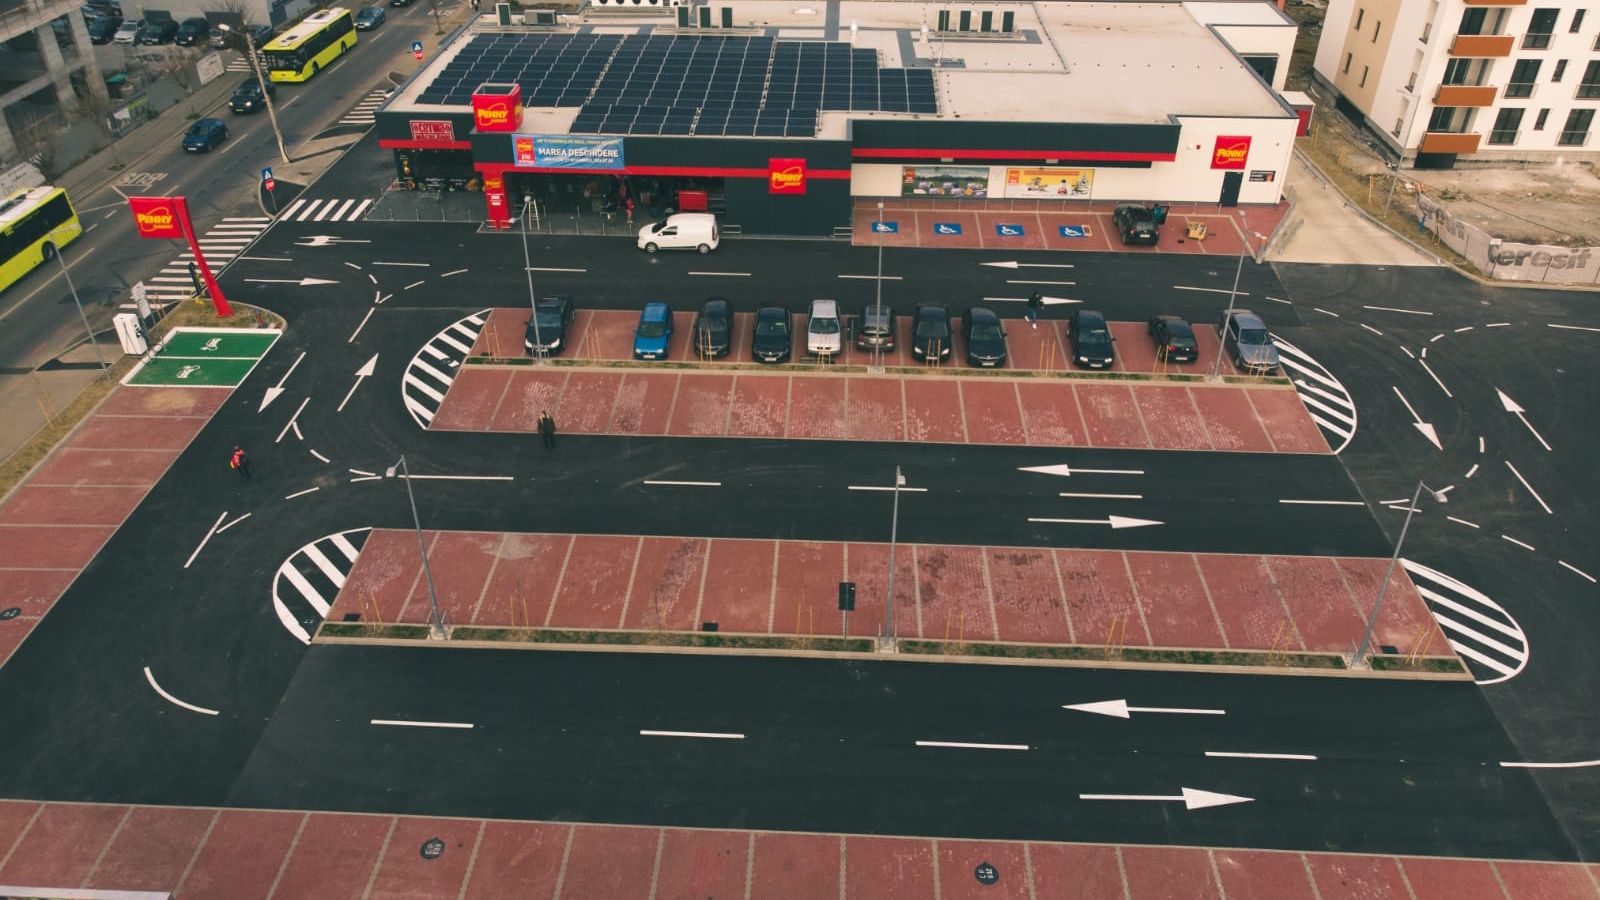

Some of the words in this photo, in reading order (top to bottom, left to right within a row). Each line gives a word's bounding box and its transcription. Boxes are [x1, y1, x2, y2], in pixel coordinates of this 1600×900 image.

[478, 109, 508, 118] PENNY
[538, 148, 567, 156] MAREA
[568, 149, 619, 158] DESCHIDERE
[1217, 148, 1248, 158] PENNY
[772, 172, 803, 182] PENNY
[138, 213, 173, 224] PENNY
